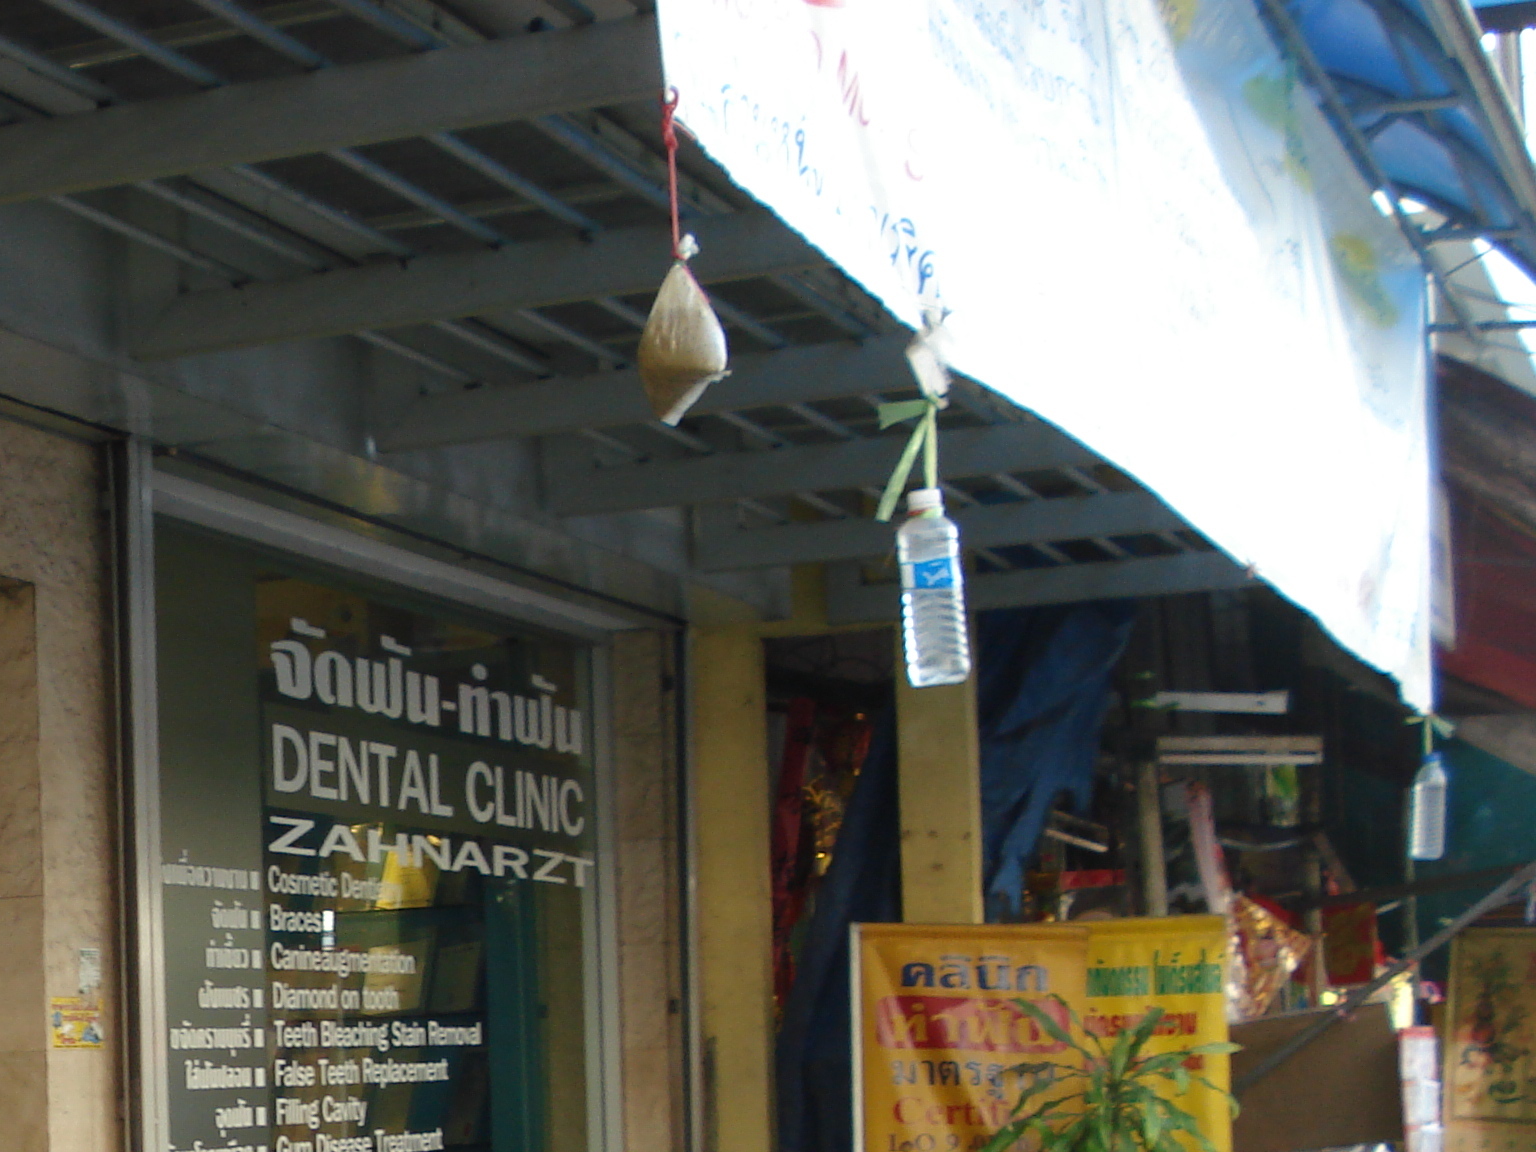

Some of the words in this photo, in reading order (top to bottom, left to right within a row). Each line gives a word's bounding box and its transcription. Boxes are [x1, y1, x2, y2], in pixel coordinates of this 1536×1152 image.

[270, 615, 583, 756] จัดฟัน-ทำฟัน
[271, 722, 454, 818] DENTAL
[465, 760, 585, 837] CLINIC
[267, 815, 595, 888] ZAHNARZT
[268, 864, 339, 899] Cosmetic
[270, 903, 323, 933] Braces
[901, 955, 1049, 993] คลินิก
[273, 981, 339, 1010] Diamond
[341, 988, 360, 1010] on
[362, 985, 400, 1011] tooth
[273, 1020, 319, 1048] Teeth
[320, 1020, 389, 1051] Bleaching
[391, 1021, 427, 1048] Stain
[428, 1021, 483, 1047] Removal
[892, 1002, 1059, 1046] ทำฟัน
[275, 1058, 316, 1087] False
[318, 1058, 361, 1086] Teeth
[363, 1057, 450, 1089] Replacement
[276, 1097, 320, 1130] Filling
[322, 1095, 368, 1127] Cavity
